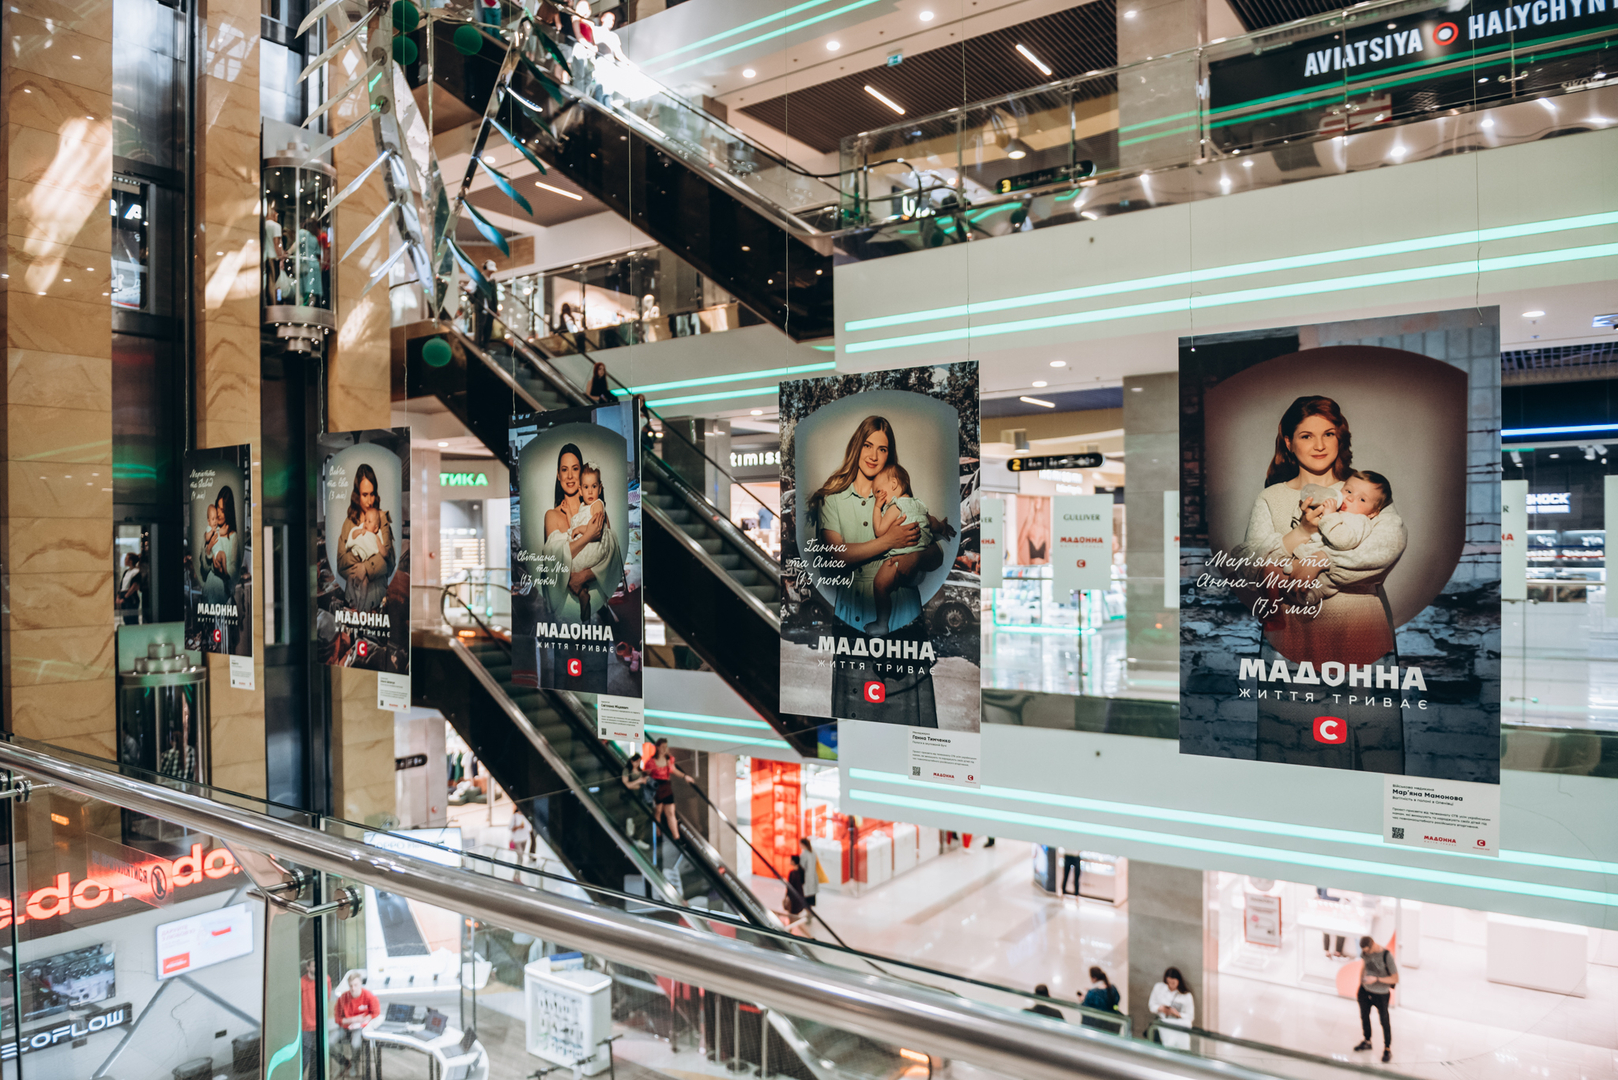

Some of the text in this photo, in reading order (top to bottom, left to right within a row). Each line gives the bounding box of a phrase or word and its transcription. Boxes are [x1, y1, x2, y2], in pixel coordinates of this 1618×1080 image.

[1304, 0, 1618, 77] AVIATSIYA HALYCHYN
[1001, 179, 1011, 193] 3
[1012, 458, 1021, 471] 2
[440, 472, 488, 486] ТИКА
[804, 538, 848, 553] Ганна
[517, 550, 556, 562] Світлана
[789, 555, 846, 569] та Аліса
[1298, 555, 1331, 568] та
[536, 561, 570, 573] та Мія
[533, 574, 558, 588] роки)
[816, 570, 854, 588] роки)
[1196, 571, 1324, 590] Анна-Марія
[197, 602, 238, 618] МАДОННА
[1252, 598, 1324, 618] (7,5 міс)
[335, 610, 390, 628] МАДОННА
[536, 622, 614, 642] МАДОННА
[537, 642, 614, 654] ЖИТТЯ ТРИВАЄ
[818, 636, 936, 661] МАДОННА
[817, 660, 936, 676] ЖИТТЯ ТРИВАЄ
[1239, 658, 1428, 692] МАДОННА
[1238, 688, 1428, 710] ЖИТТЯ ТРИВАЄ
[1392, 789, 1463, 801] Мар'яна Мамонова
[1424, 835, 1456, 844] МАДОННА
